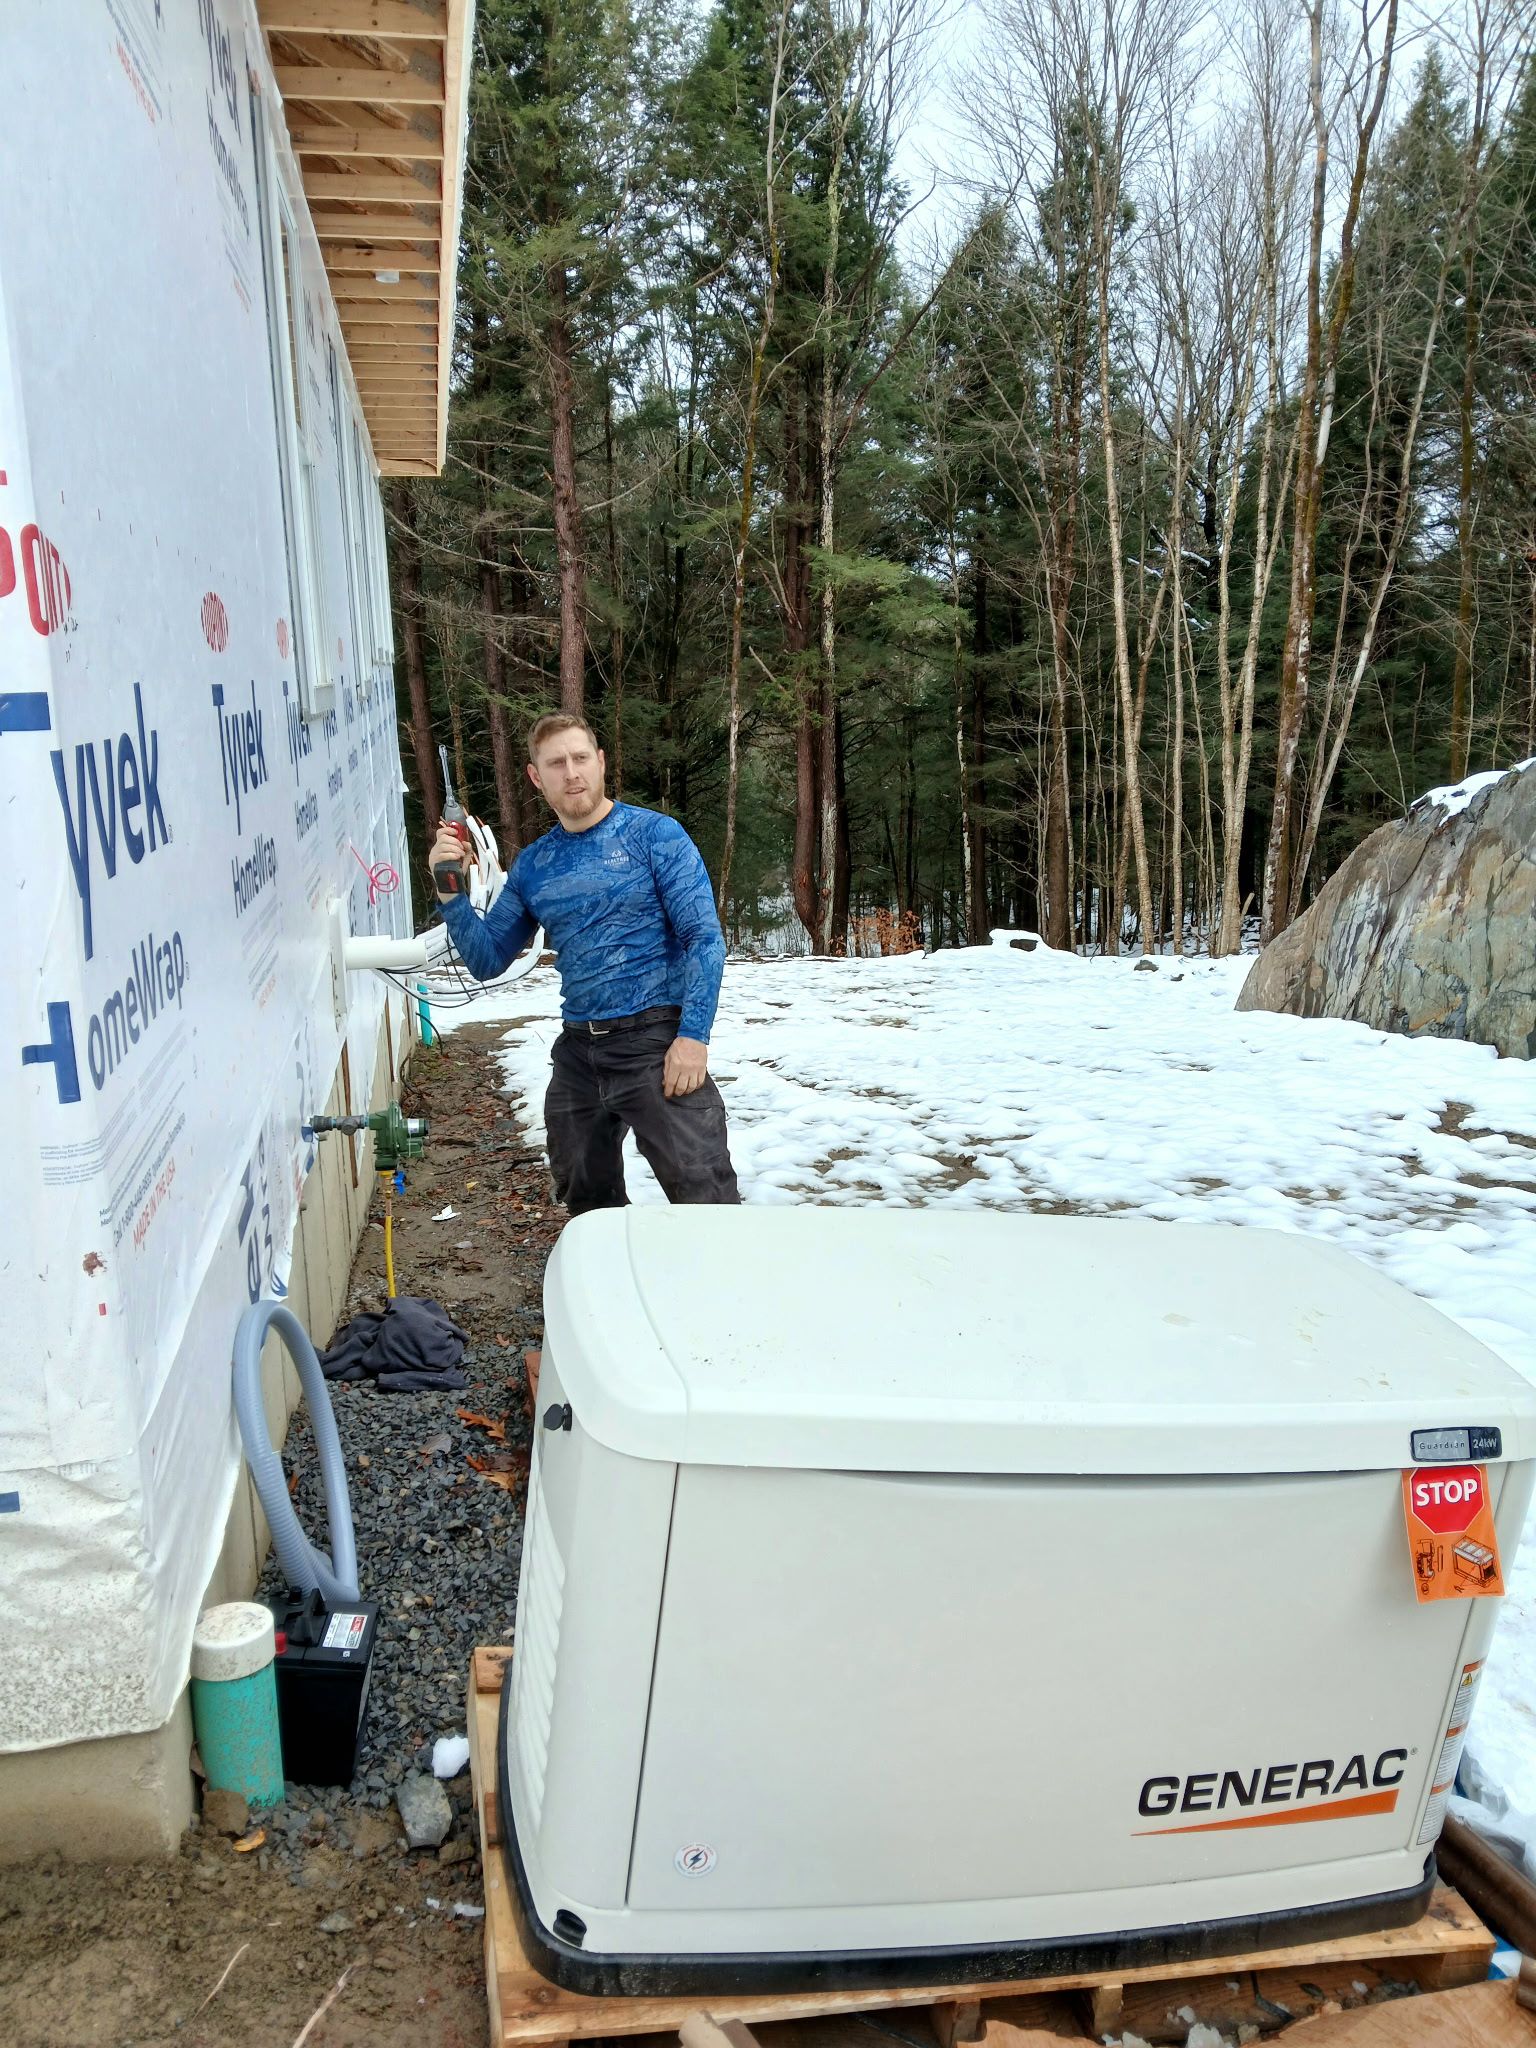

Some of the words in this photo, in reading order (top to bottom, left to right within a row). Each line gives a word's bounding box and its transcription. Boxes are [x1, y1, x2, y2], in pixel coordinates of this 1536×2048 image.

[211, 680, 268, 836] Tyvek
[231, 832, 278, 920] HomeWrap
[133, 1205, 151, 1247] MADE
[1418, 1441, 1465, 1451] Guardian
[1472, 1437, 1497, 1450] 24kW
[1415, 1478, 1479, 1508] STOP
[1138, 1747, 1408, 1818] GENERAC
